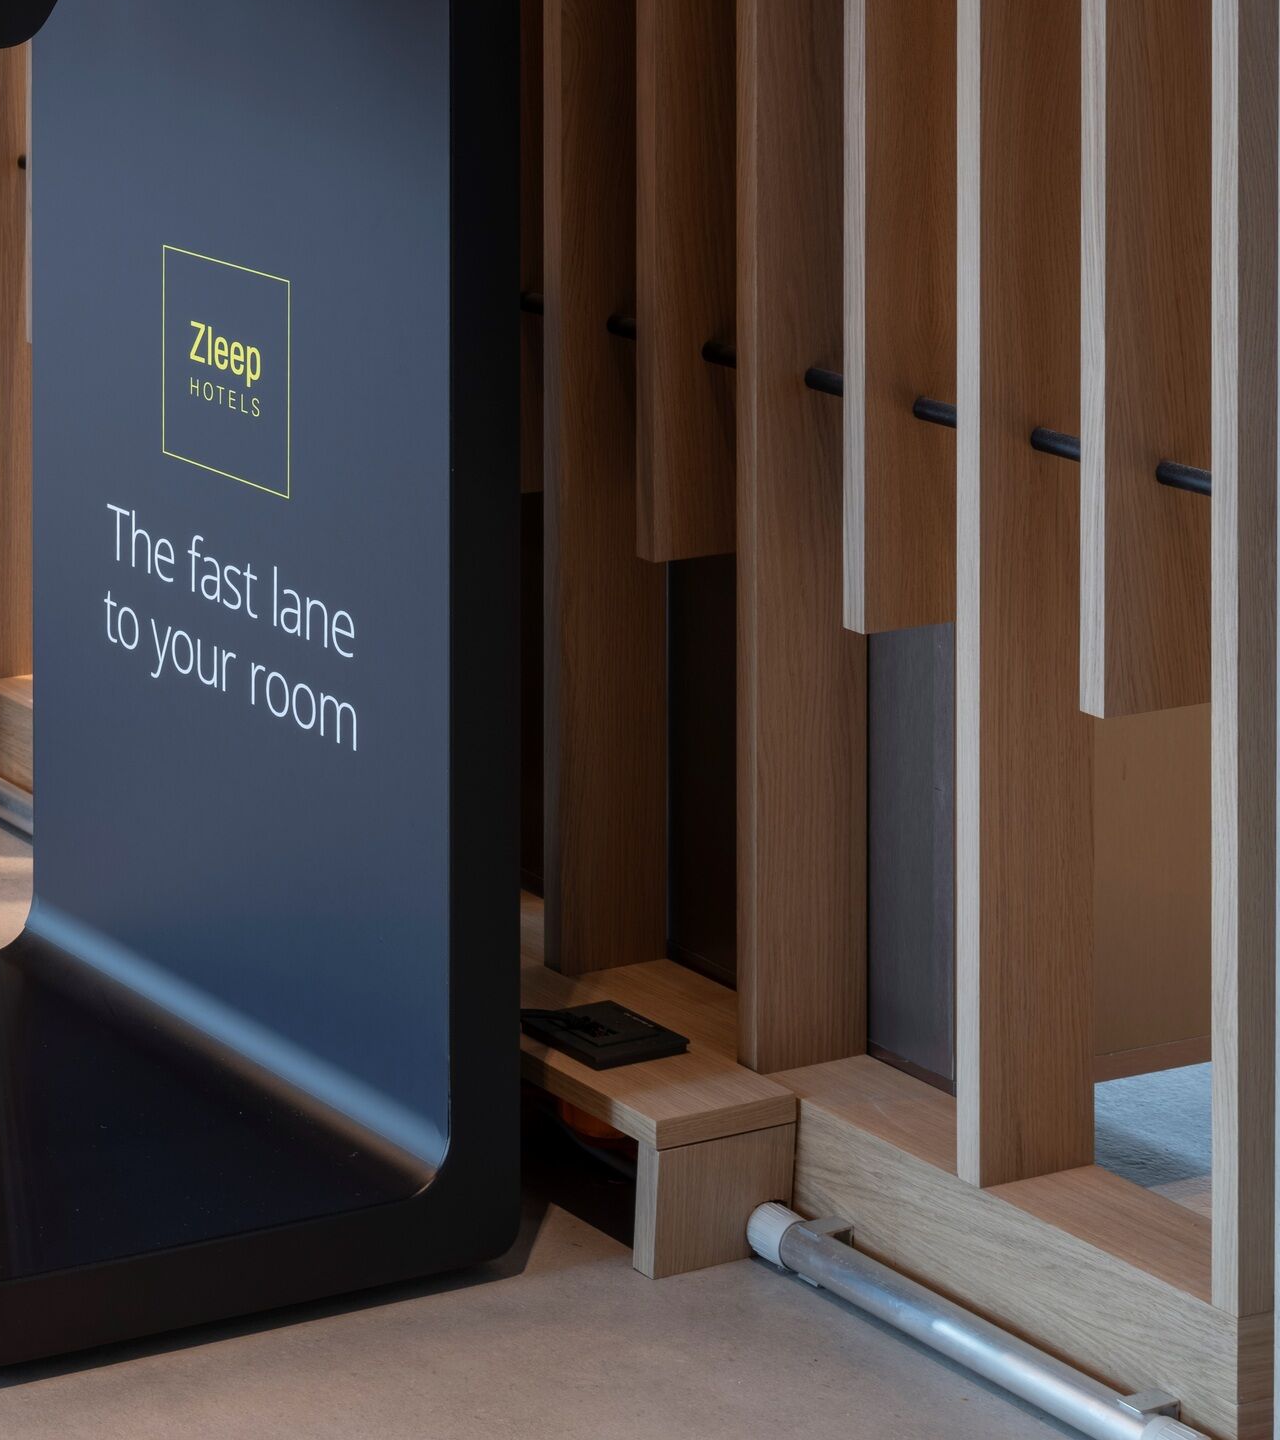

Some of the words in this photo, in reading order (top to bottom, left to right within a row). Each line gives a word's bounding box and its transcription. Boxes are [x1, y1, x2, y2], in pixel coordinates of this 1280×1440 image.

[189, 320, 261, 388] Zleep
[190, 376, 261, 417] HOTELS
[106, 503, 175, 583] The
[187, 534, 258, 619] fast
[273, 565, 355, 658] lane
[103, 590, 140, 650] to
[150, 618, 237, 692] your
[251, 662, 357, 752] room
